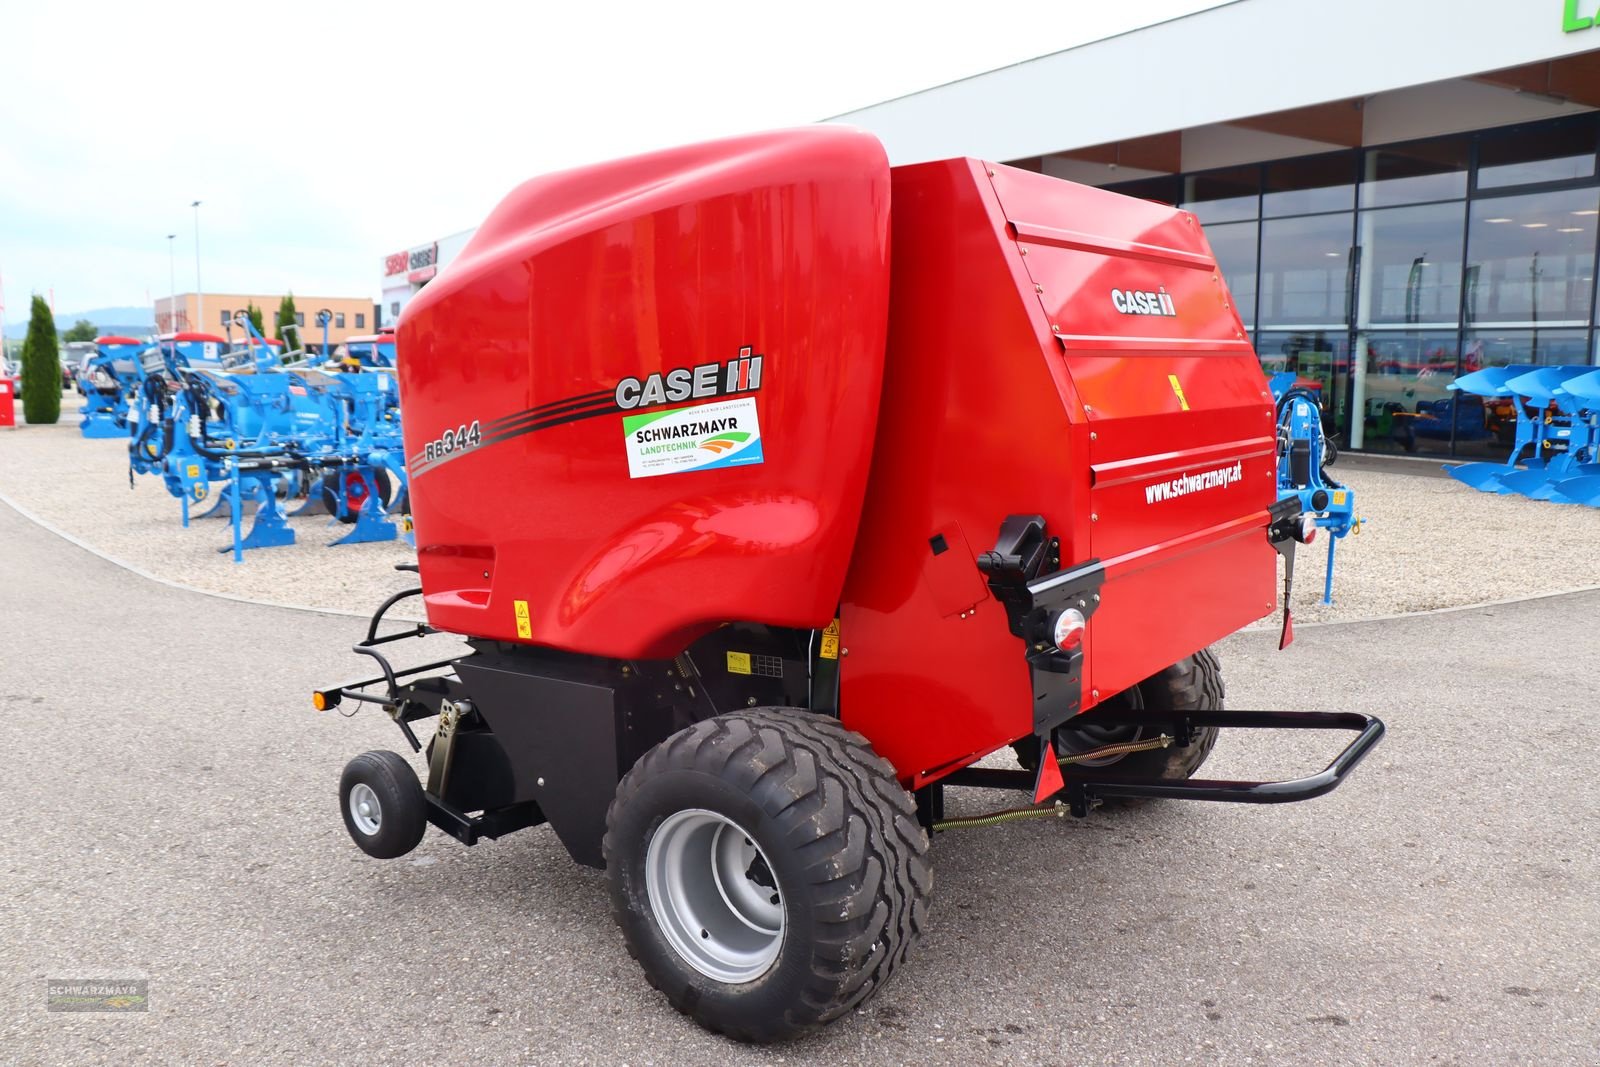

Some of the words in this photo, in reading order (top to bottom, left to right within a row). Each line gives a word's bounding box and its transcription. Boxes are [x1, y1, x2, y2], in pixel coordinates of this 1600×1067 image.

[1562, 0, 1600, 33] L
[1111, 288, 1161, 315] CASE
[615, 363, 719, 409] CASE
[636, 417, 738, 444] SCHWARZMAYR
[640, 441, 697, 456] LANDTECHNIK
[1145, 459, 1242, 505] www.schwarzmayr.at
